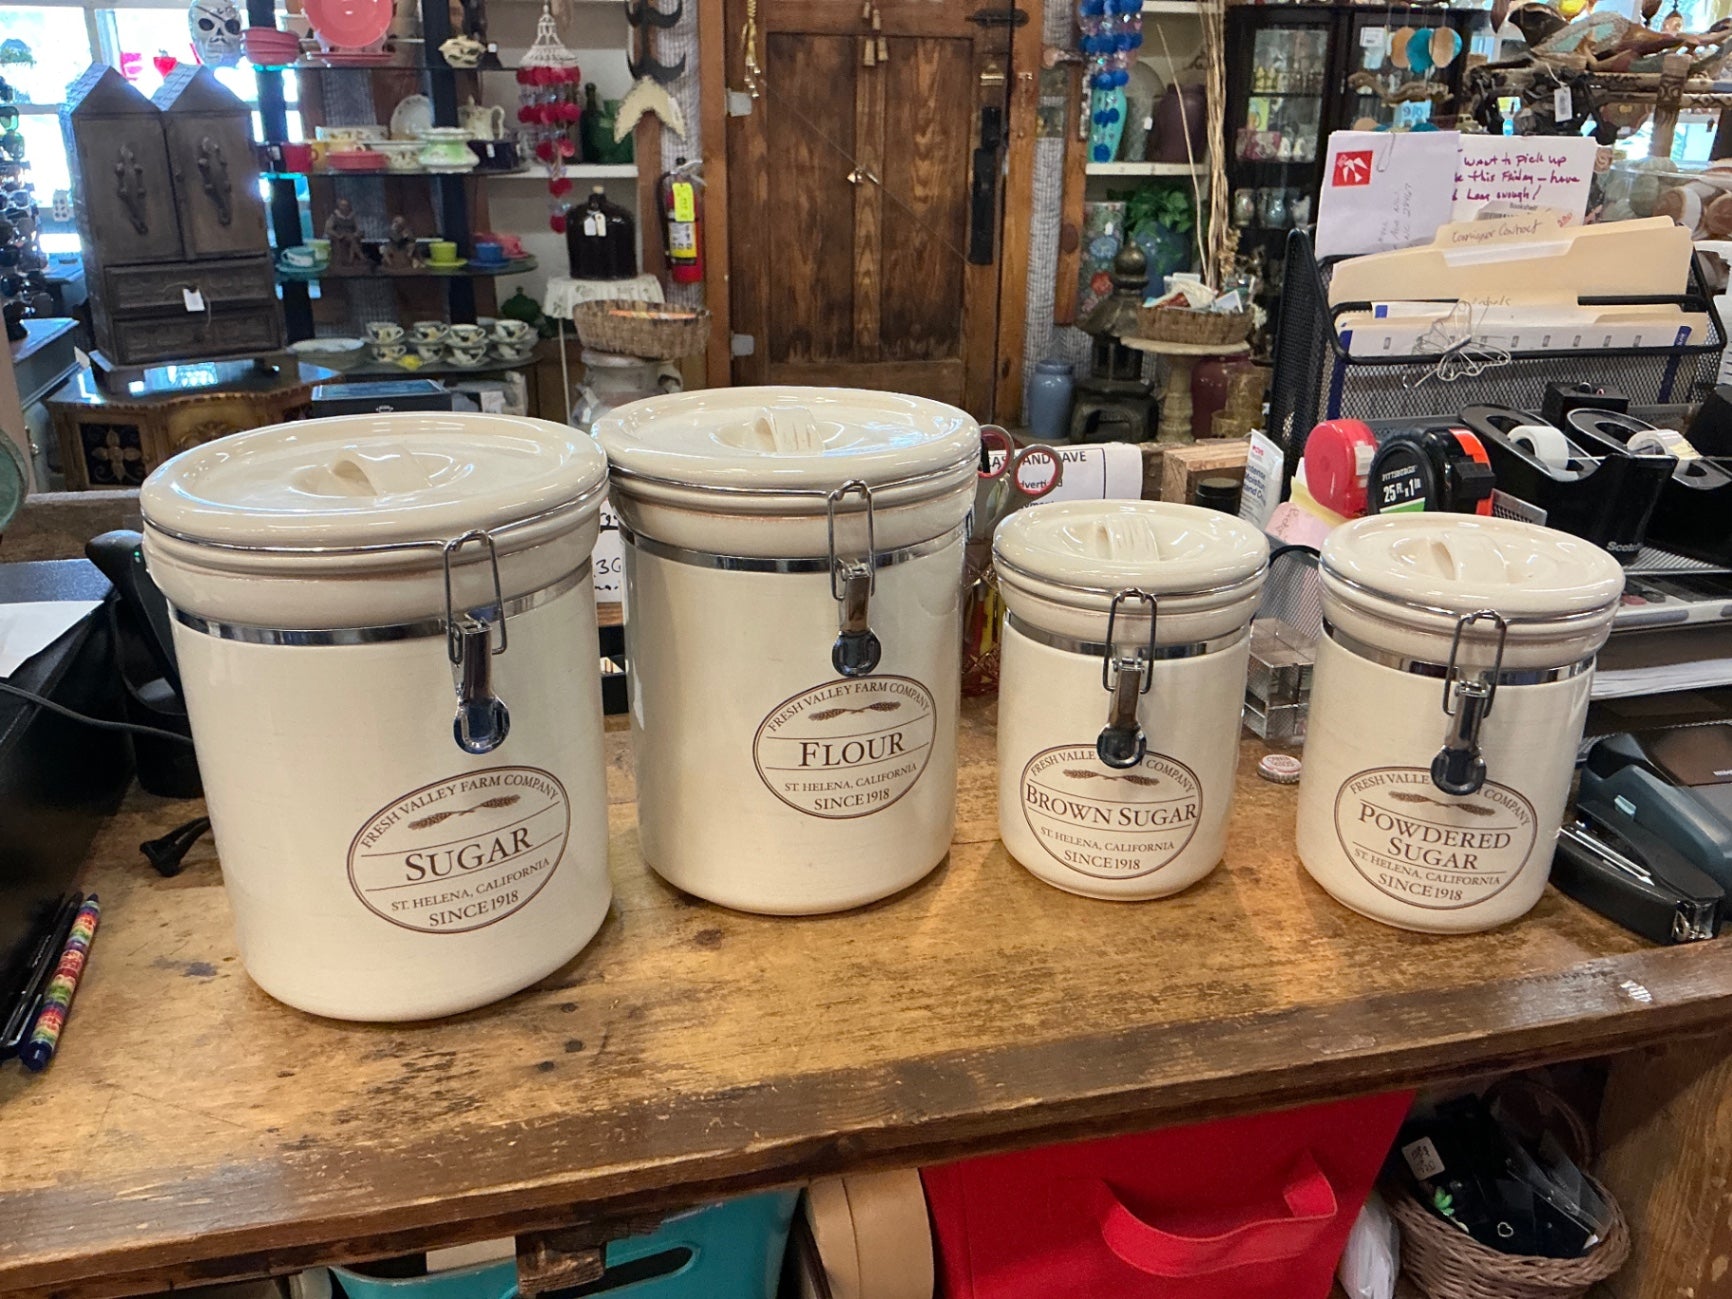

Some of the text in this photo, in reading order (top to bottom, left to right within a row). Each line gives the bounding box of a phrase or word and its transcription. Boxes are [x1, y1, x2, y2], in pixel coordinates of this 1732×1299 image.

[1467, 169, 1495, 182] this
[1549, 155, 1567, 167] up
[1061, 451, 1087, 462] AVE
[768, 682, 930, 732] FRESH VALLEY FARM COMPANY
[799, 732, 905, 767] FLOUR
[803, 781, 853, 791] HELENA,
[856, 763, 917, 787] CALIFORNIA
[1030, 751, 1195, 792] FRESH VALLE COMPANY
[361, 774, 558, 848] FRESH VALLEY FARM COMPANY
[815, 788, 890, 810] SINCE 1918
[1026, 783, 1197, 826] BROWN SUGAR
[1350, 774, 1385, 795] FRESH
[1386, 774, 1430, 784] VALLE
[1484, 789, 1530, 826] COMPANY
[1359, 803, 1511, 849] POWDERED
[405, 827, 533, 882] SUGAR
[1064, 850, 1140, 870] SINCE 1918
[1105, 841, 1174, 852] CALIFORNIA
[1388, 837, 1478, 869] SUGAR
[413, 890, 474, 908] HELENA,
[476, 858, 550, 893] CALIFORNIA
[1379, 873, 1463, 900] SINCE 1918
[1426, 871, 1500, 885] CALIFORNIA
[430, 891, 519, 927] SINCE 1918
